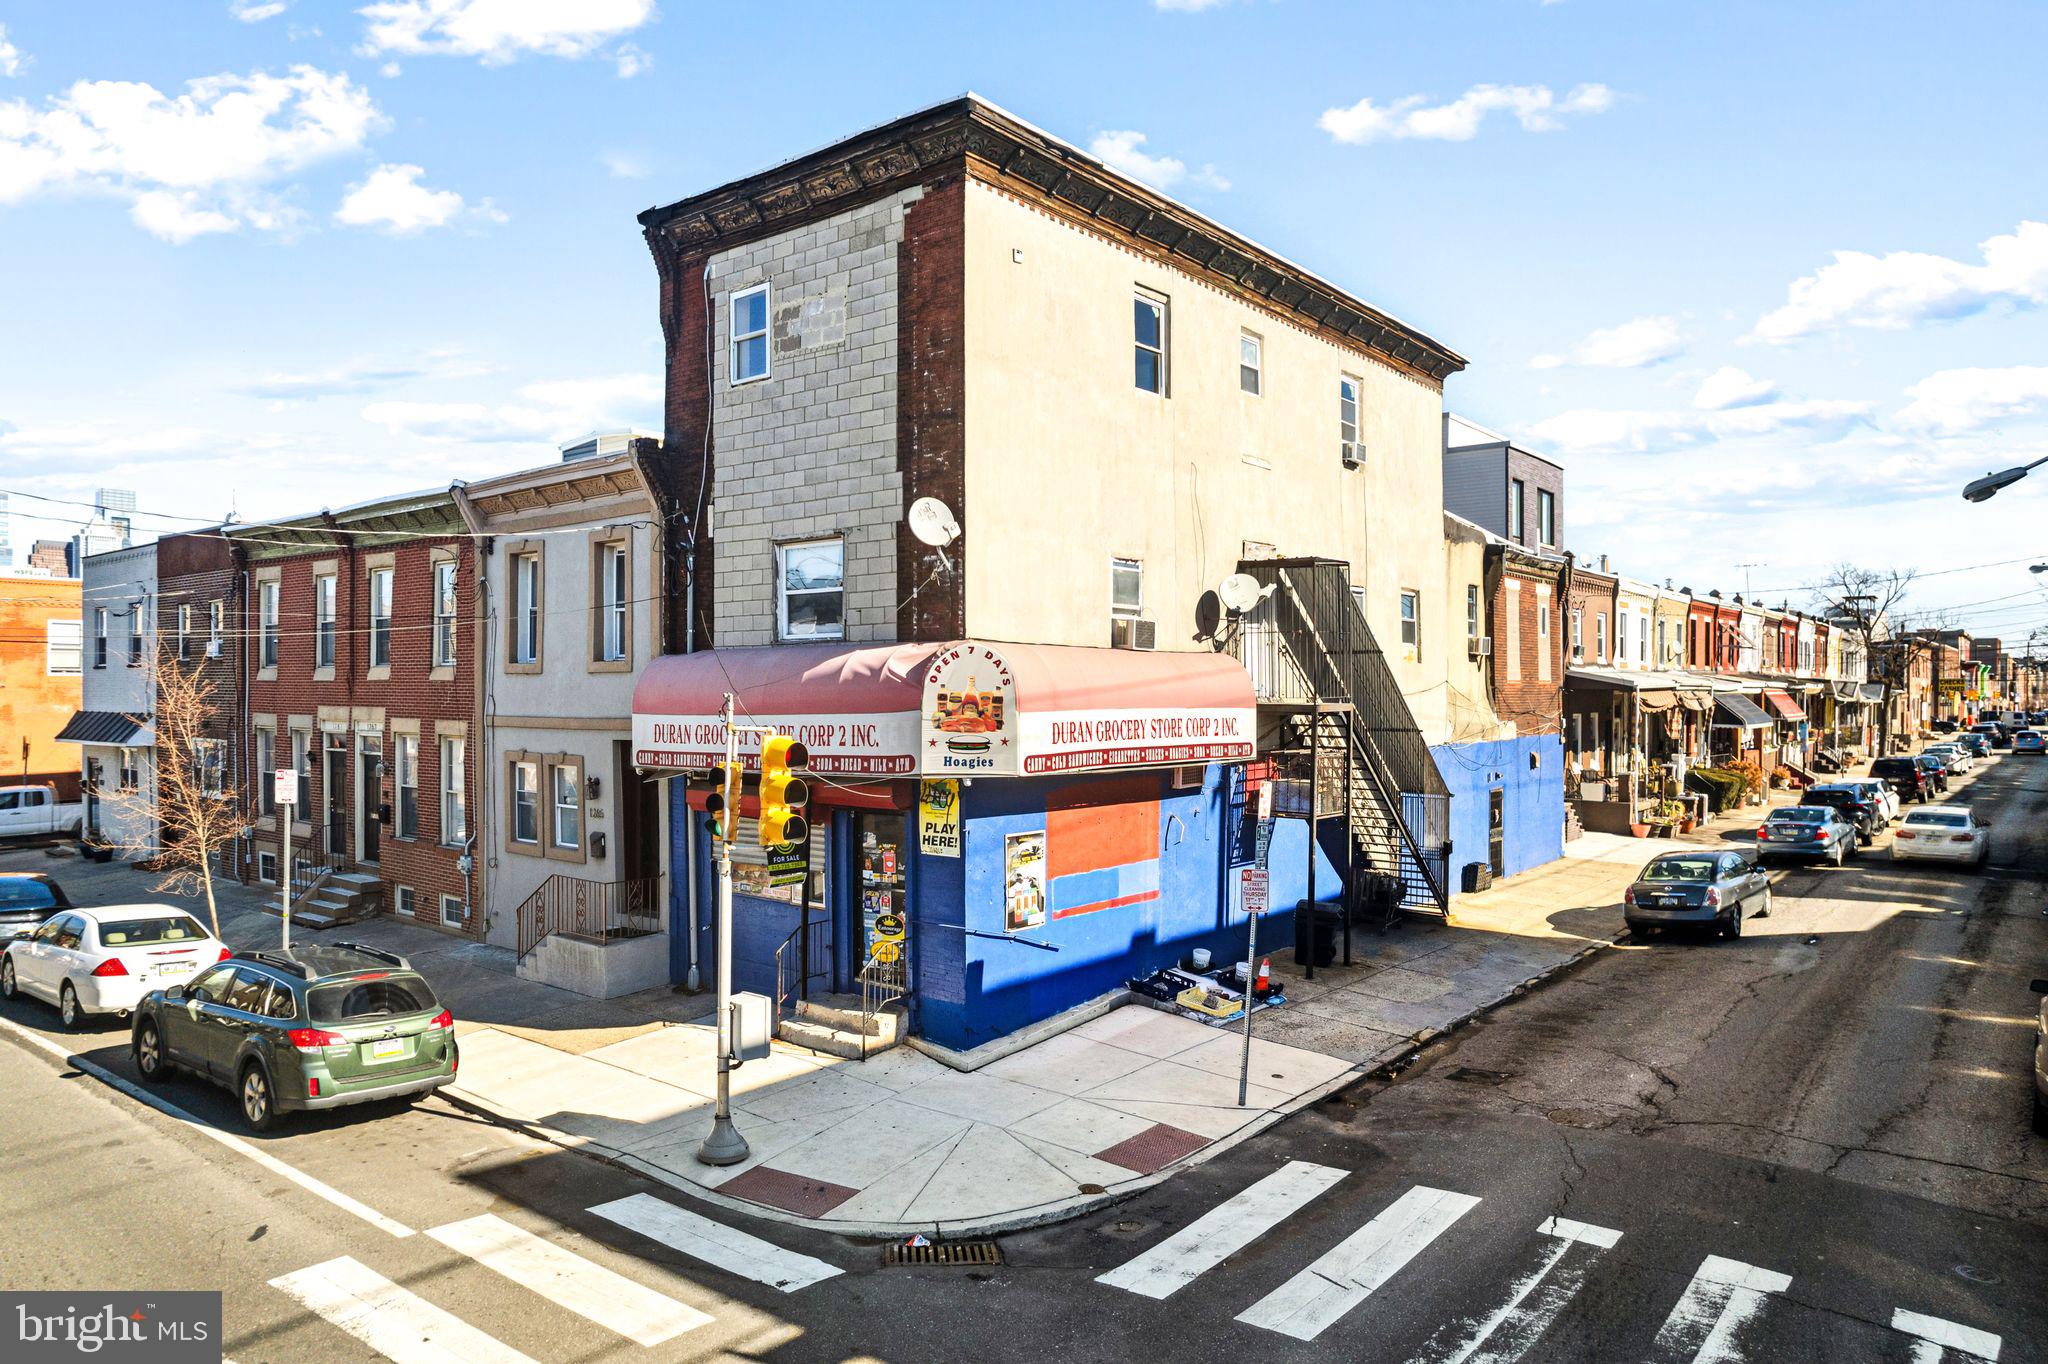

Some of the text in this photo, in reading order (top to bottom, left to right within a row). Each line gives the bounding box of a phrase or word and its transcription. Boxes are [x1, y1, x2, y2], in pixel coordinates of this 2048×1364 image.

[929, 646, 1011, 686] OPEN 7 DAYS
[654, 723, 691, 745] DURAN
[799, 725, 834, 747] CORP
[839, 725, 846, 747] 2
[851, 724, 879, 748] INC.
[1052, 717, 1239, 745] DURAN GROCERY STORE CORP 2 INC.
[638, 752, 654, 764] CANDY
[659, 752, 671, 765] COLD
[673, 752, 707, 767] SANDWICHES
[816, 757, 910, 772] SODA BREAD MILK ATM
[943, 756, 994, 769] Hoagies
[1027, 757, 1046, 772] CANDY
[1052, 755, 1066, 770] COLD
[1068, 751, 1103, 768] SANDWICHES
[1109, 749, 1141, 764] CIGARETTES
[1146, 748, 1164, 762] SNACKS
[925, 822, 956, 835] PLAY
[922, 835, 958, 848] HERE!
[1243, 871, 1251, 880] NO
